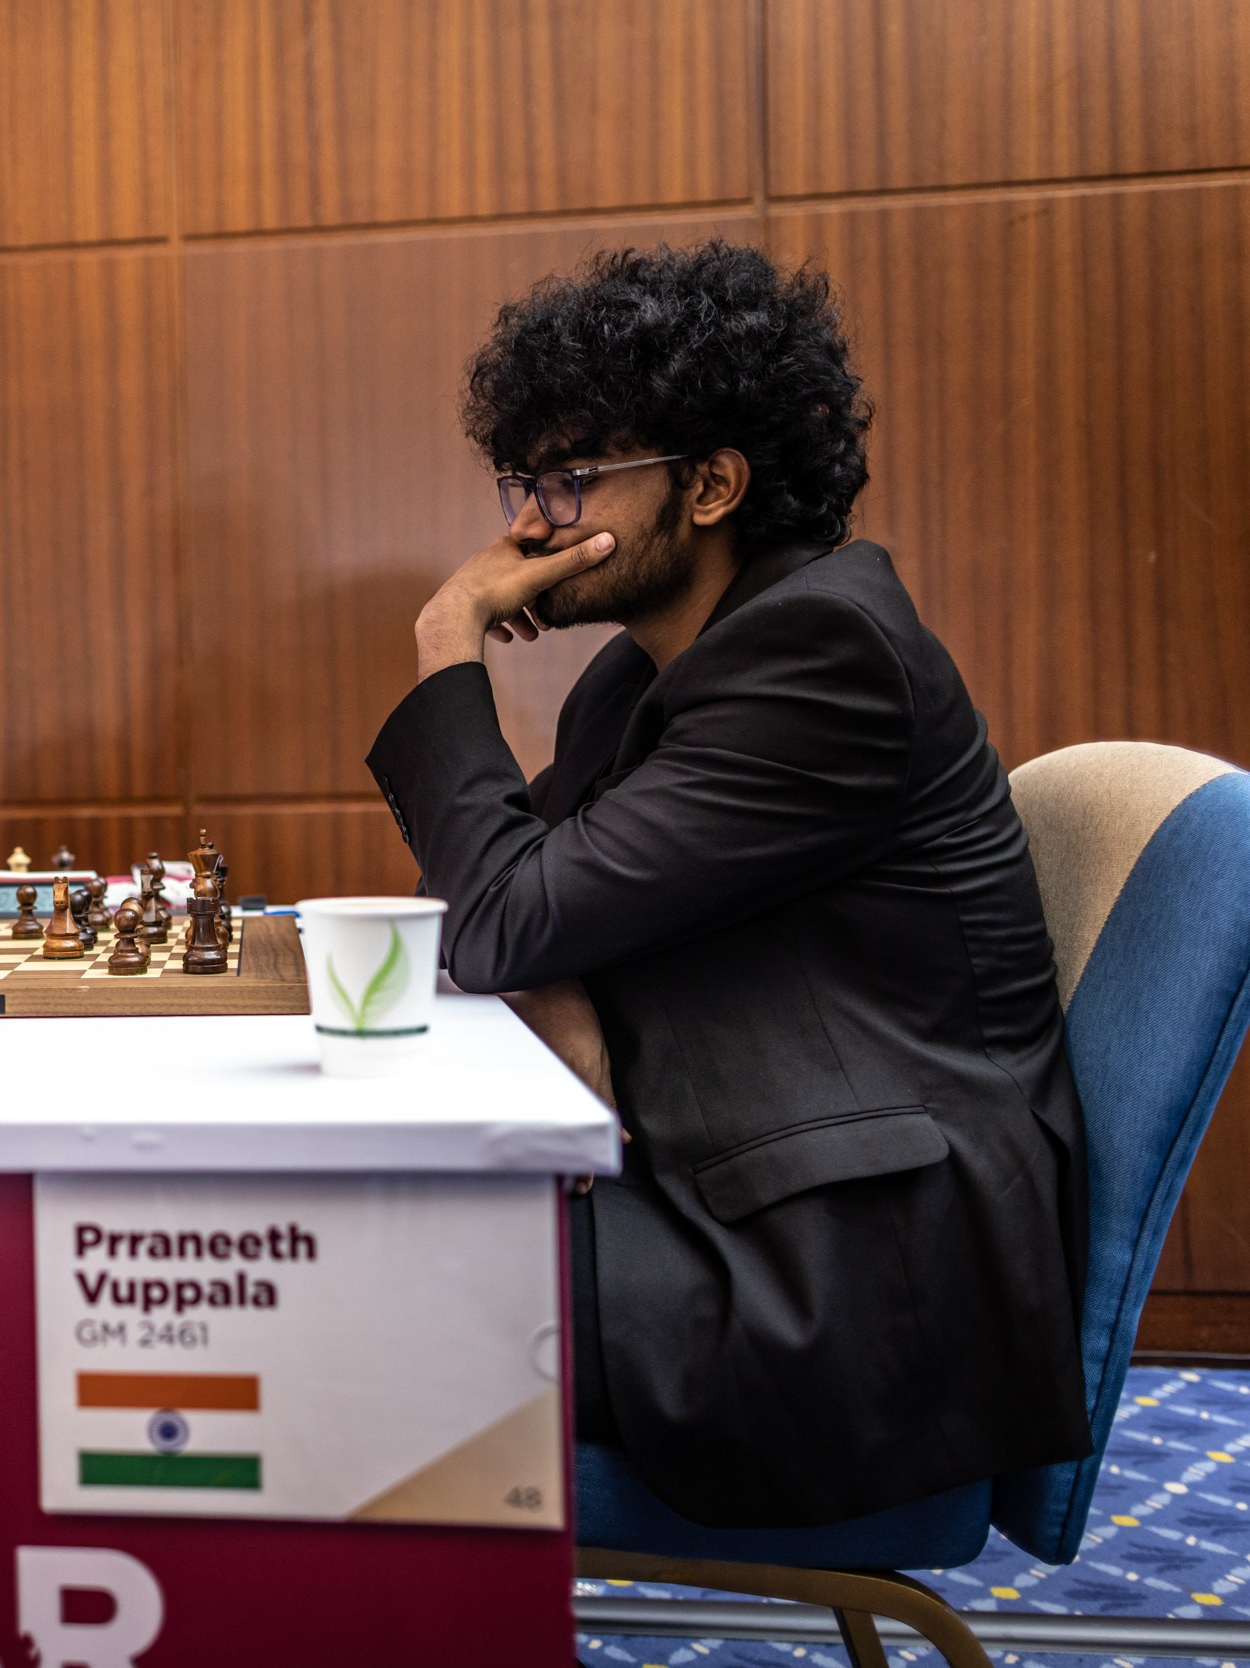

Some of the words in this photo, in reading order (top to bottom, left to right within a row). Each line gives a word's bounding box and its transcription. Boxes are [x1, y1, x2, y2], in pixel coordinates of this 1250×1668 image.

[74, 1222, 317, 1262] Prraneeth
[74, 1270, 278, 1314] Vuppala
[76, 1320, 126, 1348] GM
[137, 1320, 208, 1349] 2461
[504, 1486, 542, 1510] 48
